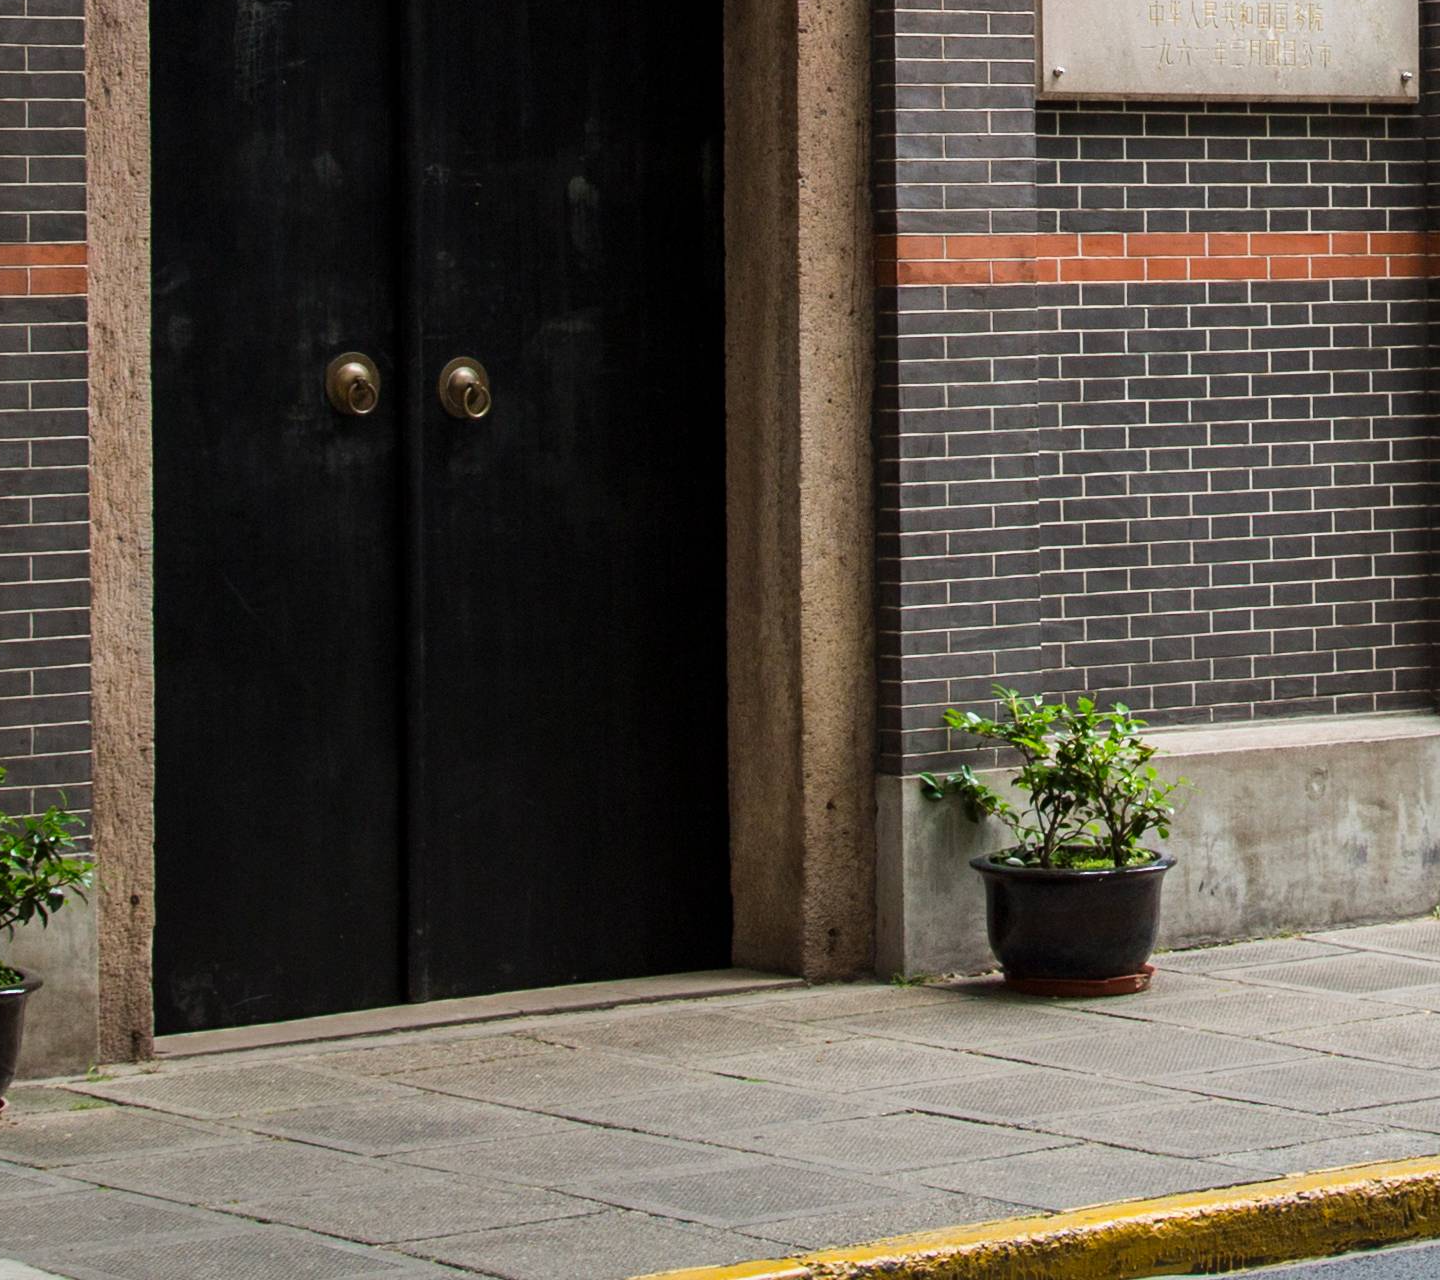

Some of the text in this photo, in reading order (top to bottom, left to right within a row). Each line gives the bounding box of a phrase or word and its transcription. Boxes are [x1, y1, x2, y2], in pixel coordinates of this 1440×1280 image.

[1148, 0, 1325, 33] 中华人民共和国国务院
